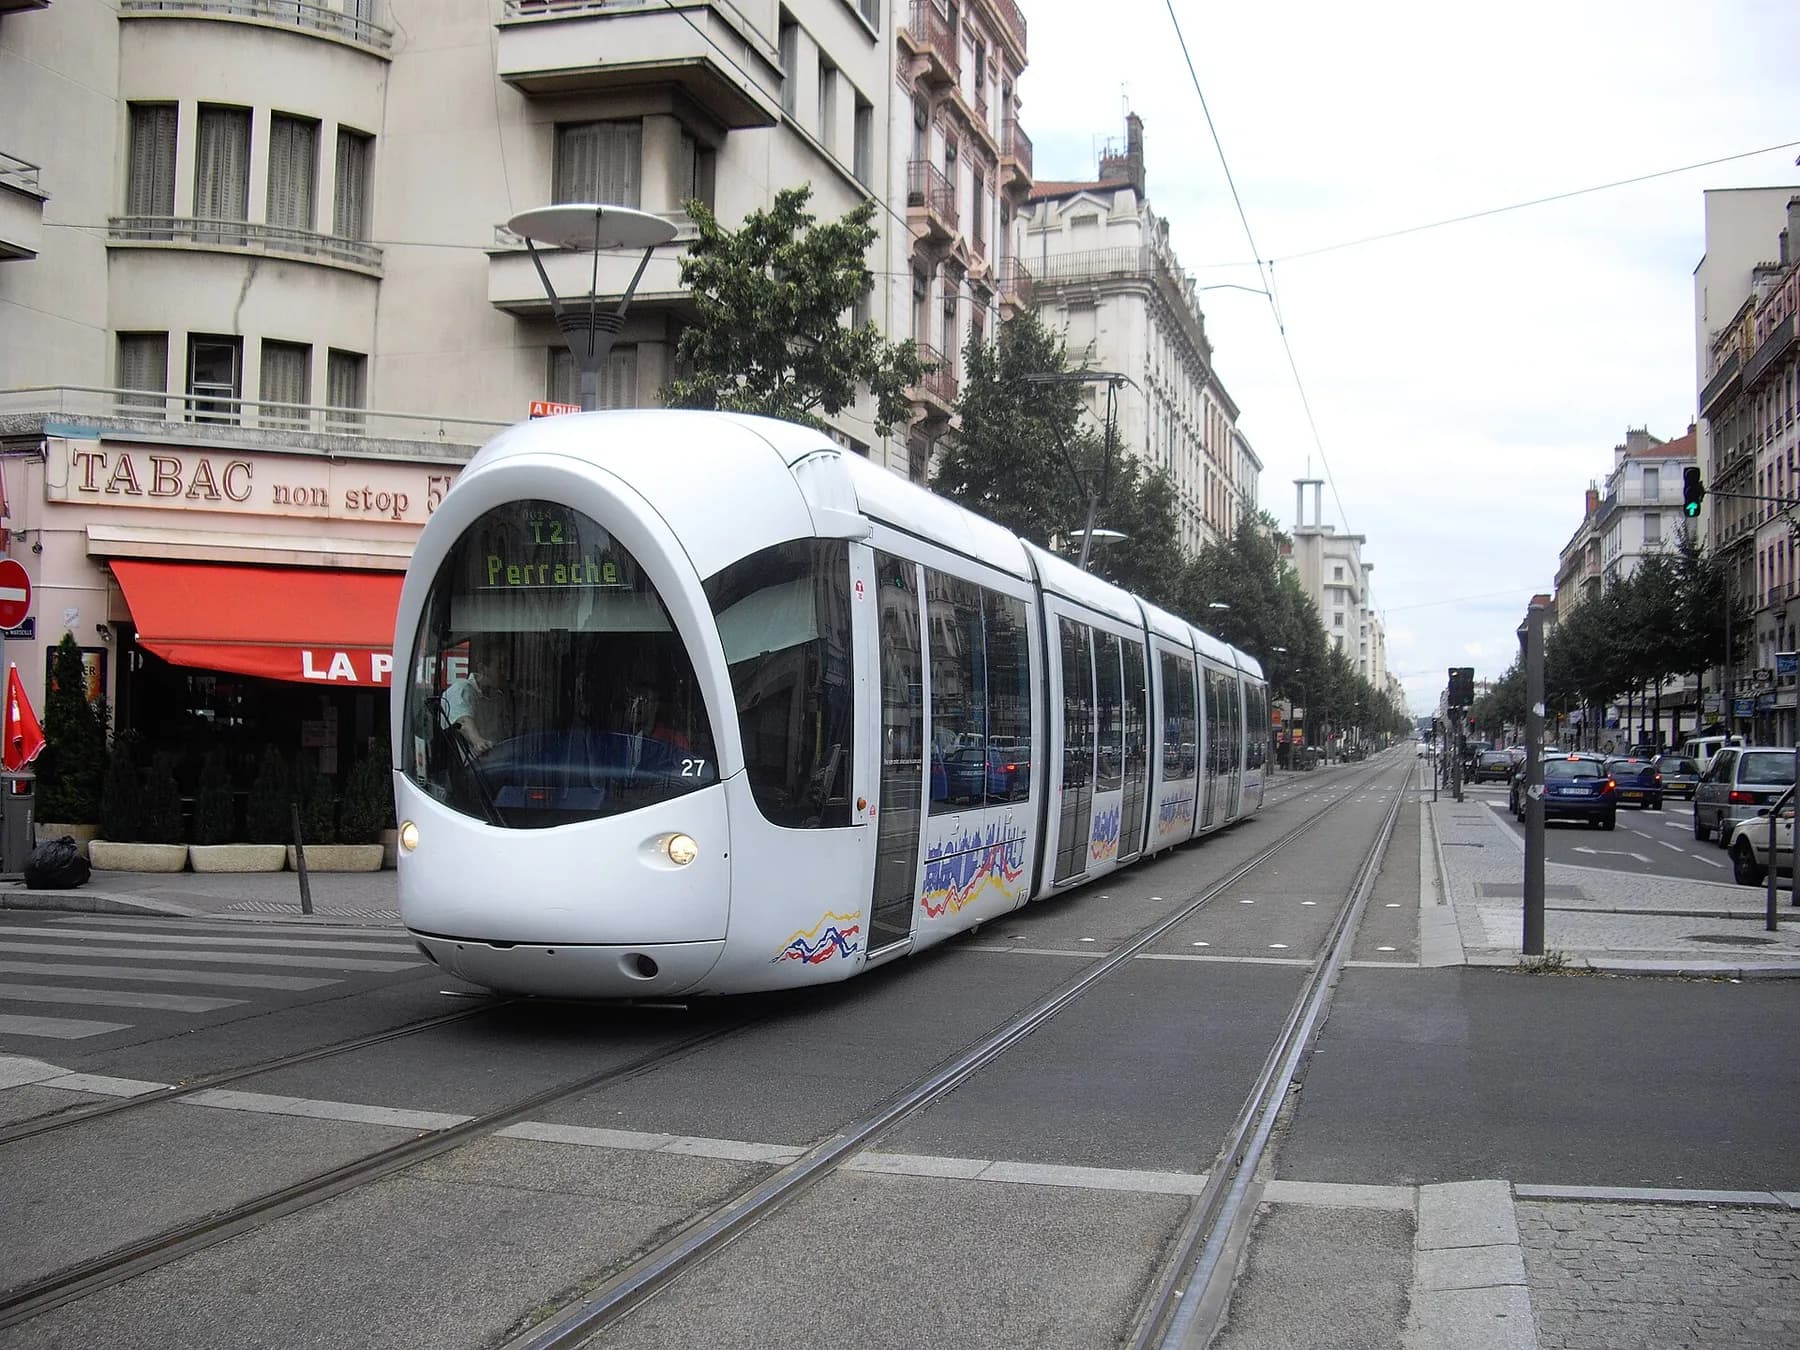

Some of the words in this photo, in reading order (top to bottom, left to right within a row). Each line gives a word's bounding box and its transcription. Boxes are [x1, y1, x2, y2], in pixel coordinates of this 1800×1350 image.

[533, 403, 543, 415] A
[73, 448, 254, 502] TABAC
[272, 484, 329, 508] non
[345, 485, 409, 520] stop
[530, 520, 564, 544] T2
[487, 554, 617, 586] Perrache
[302, 650, 358, 682] LA
[681, 758, 705, 777] 27
